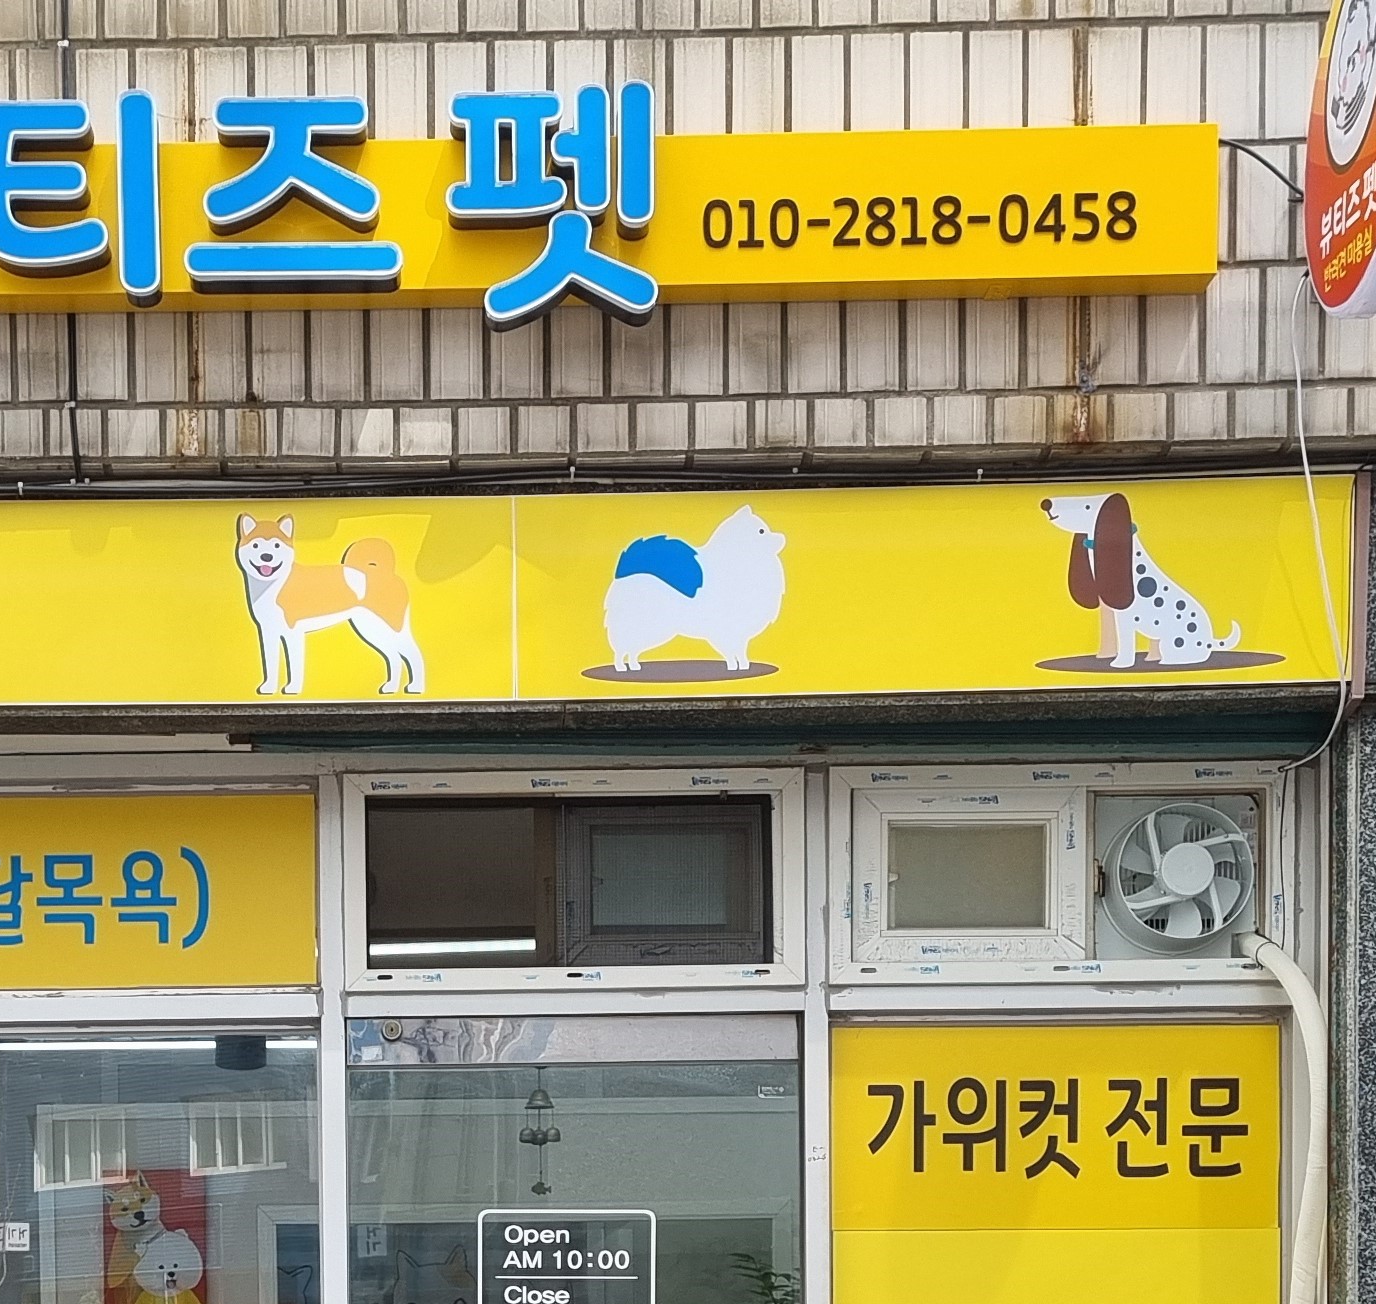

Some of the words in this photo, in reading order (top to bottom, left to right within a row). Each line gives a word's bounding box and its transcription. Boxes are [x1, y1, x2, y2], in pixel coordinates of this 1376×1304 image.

[447, 80, 659, 327] 펫
[703, 190, 1137, 249] 010-2818-0458
[1319, 178, 1362, 260] 뷰티즈
[867, 1079, 1081, 1179] 가위컷
[1105, 1077, 1249, 1176] 전문
[502, 1249, 542, 1270] AM
[552, 1249, 630, 1271] 10:00
[503, 1225, 570, 1250] Open
